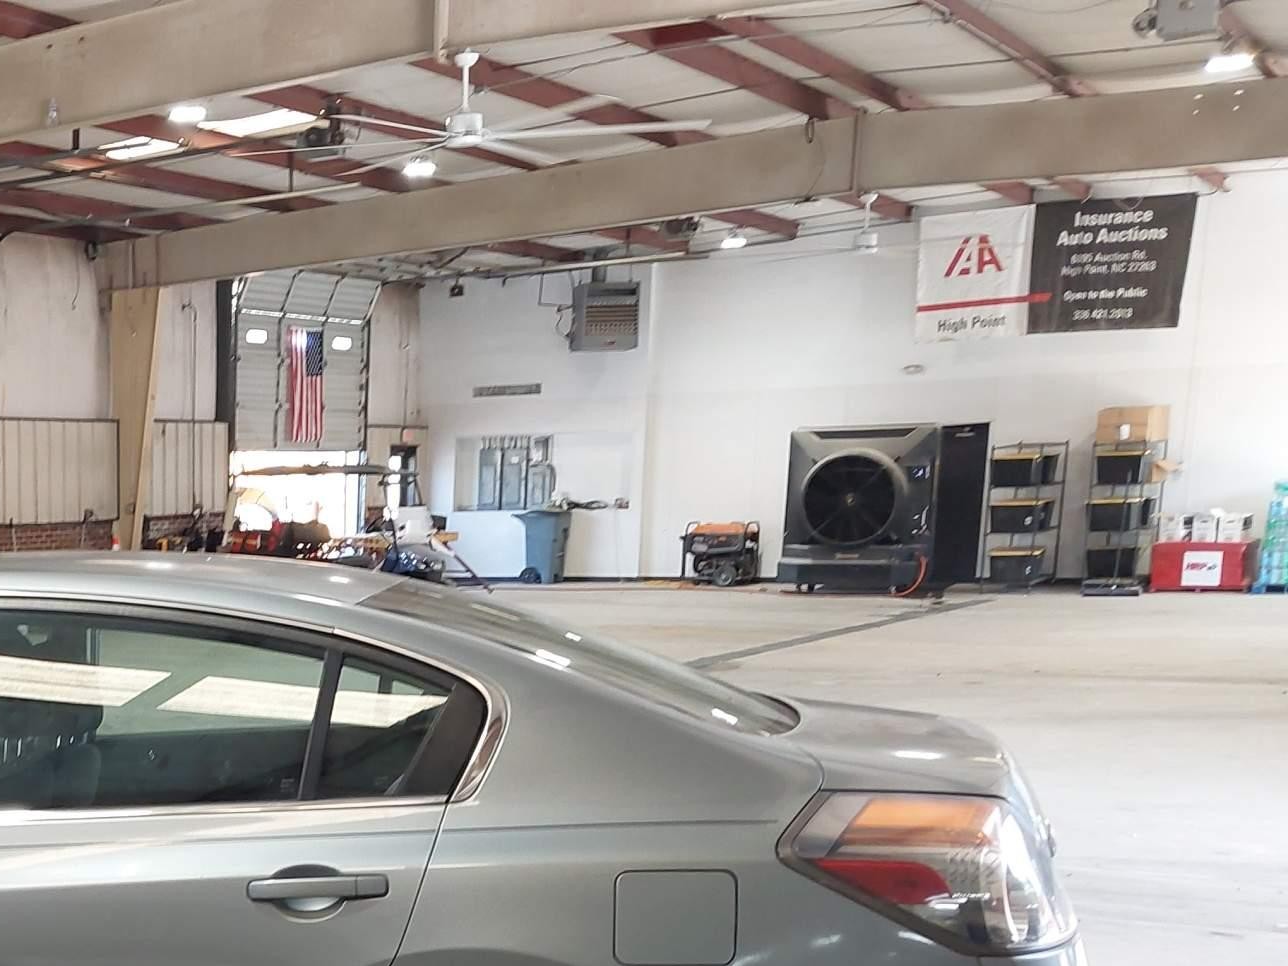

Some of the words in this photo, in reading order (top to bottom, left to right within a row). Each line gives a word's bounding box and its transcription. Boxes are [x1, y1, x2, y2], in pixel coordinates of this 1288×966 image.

[1074, 210, 1154, 227] Insurance
[1056, 230, 1094, 246] Auto
[1096, 226, 1169, 244] Auctions
[1094, 251, 1132, 262] Auction
[1116, 287, 1149, 298] Public
[937, 317, 968, 334] High
[971, 313, 1006, 329] Point
